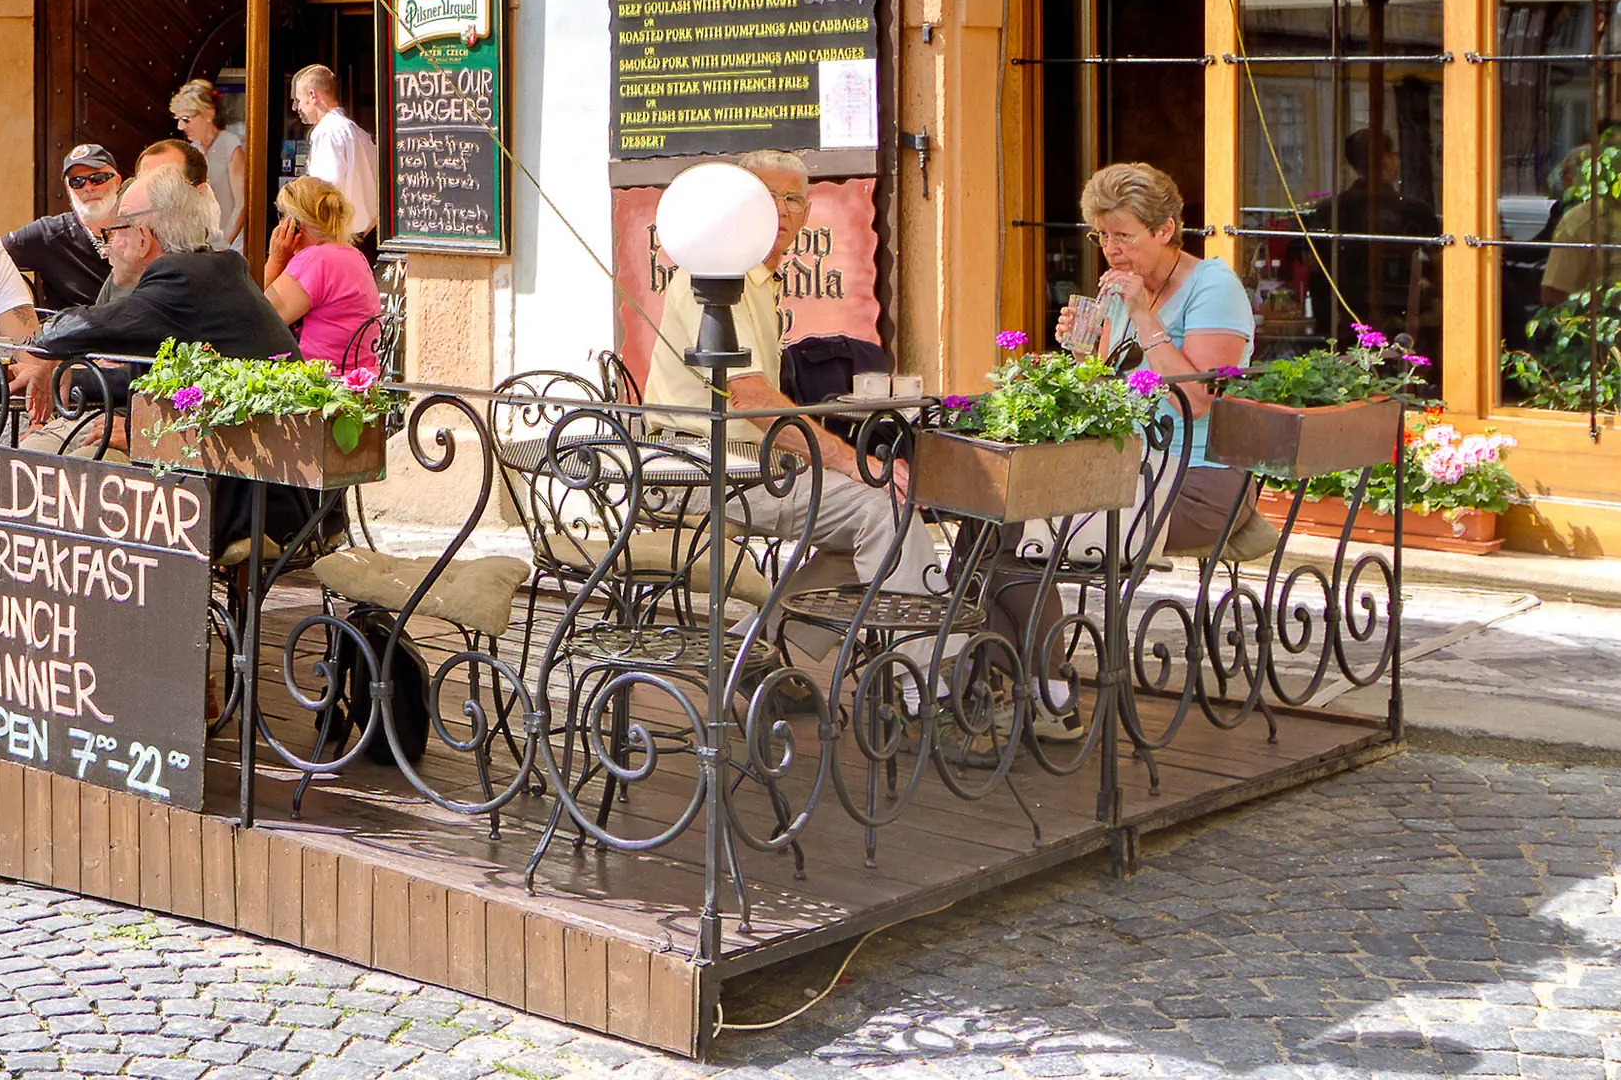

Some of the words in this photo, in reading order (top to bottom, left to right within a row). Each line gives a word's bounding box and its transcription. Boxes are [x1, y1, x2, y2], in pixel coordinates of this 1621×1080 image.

[405, 0, 442, 31] Pilsner
[619, 29, 664, 44] ROASTED
[665, 28, 693, 42] PORK
[695, 26, 723, 40] WITH
[725, 23, 785, 39] DUMPLINGS
[788, 20, 811, 34] AND
[619, 58, 660, 72] SMOKED
[662, 56, 689, 69] PORK
[691, 54, 719, 67] WITH
[721, 50, 781, 66] DUMPLINGS
[784, 49, 807, 62] AND
[394, 69, 455, 98] TASTE
[458, 67, 493, 97] OUR
[620, 83, 665, 98] CHICKEN
[667, 80, 700, 94] STEAK
[703, 79, 731, 93] WITH
[733, 77, 777, 91] FRENCH
[779, 75, 810, 89] FRIES
[396, 96, 492, 122] BURGERS
[620, 111, 650, 125] FRIED
[678, 107, 712, 121] STEAK
[714, 106, 743, 120] WITH
[745, 104, 788, 119] FRENCH
[790, 103, 821, 117] FRIES
[99, 474, 210, 563] STAR
